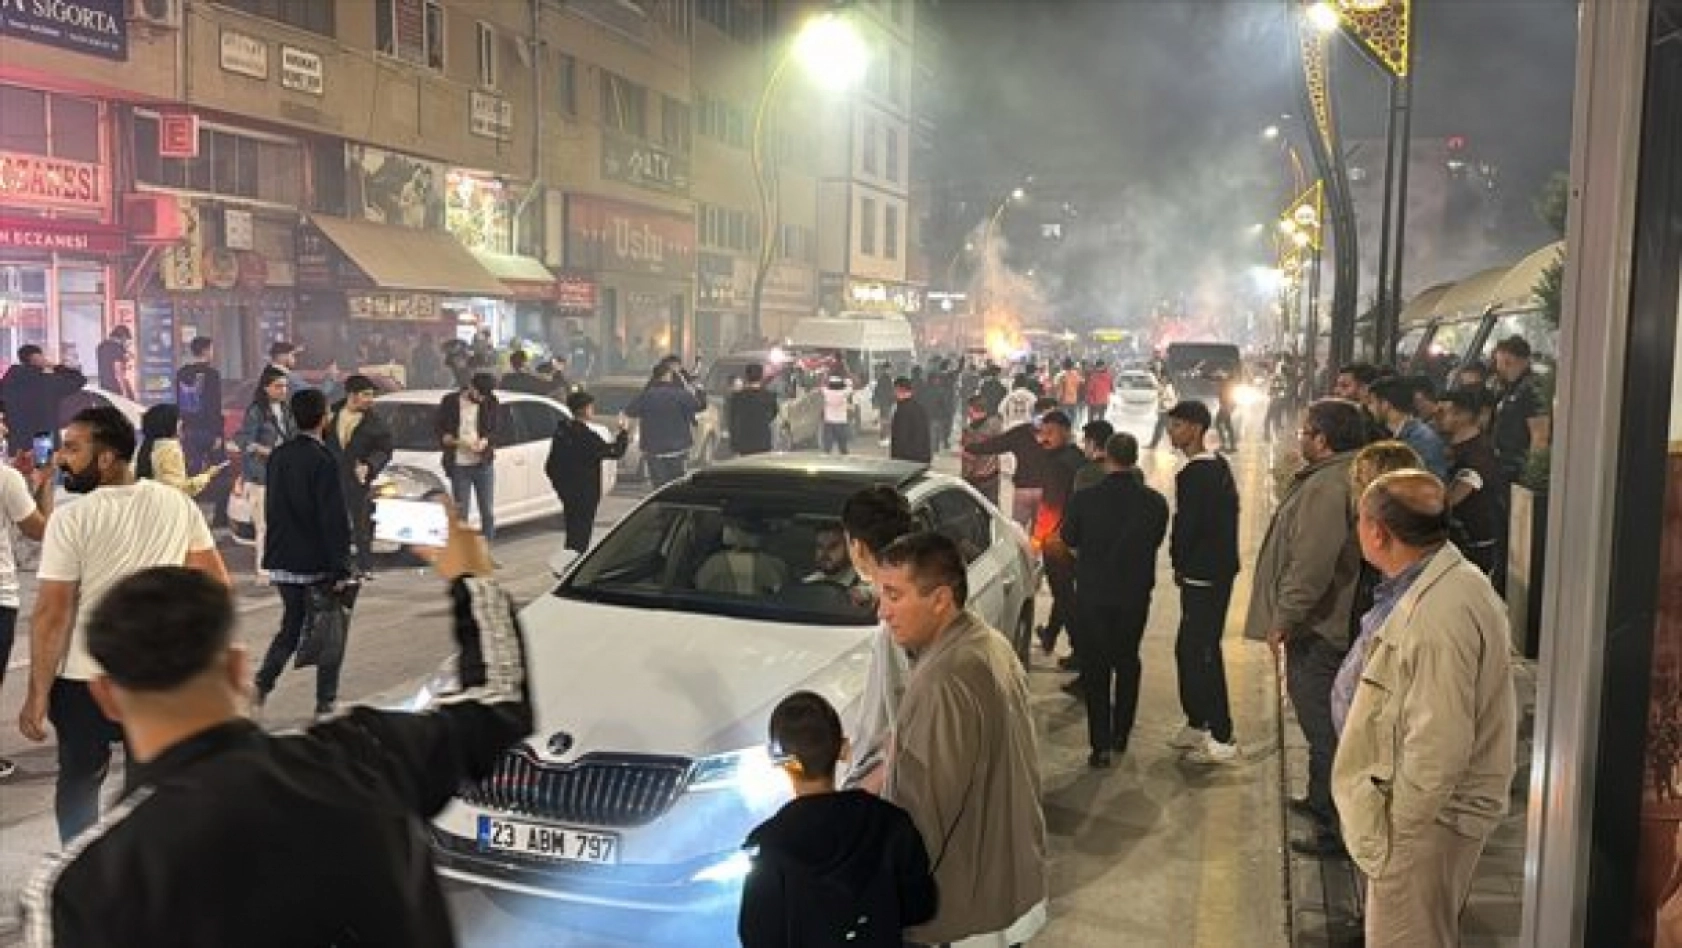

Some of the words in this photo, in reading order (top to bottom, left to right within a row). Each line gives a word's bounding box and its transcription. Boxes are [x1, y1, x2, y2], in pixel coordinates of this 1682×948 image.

[492, 821, 516, 848] 23
[527, 828, 565, 856] ABM
[575, 835, 615, 862] 797
